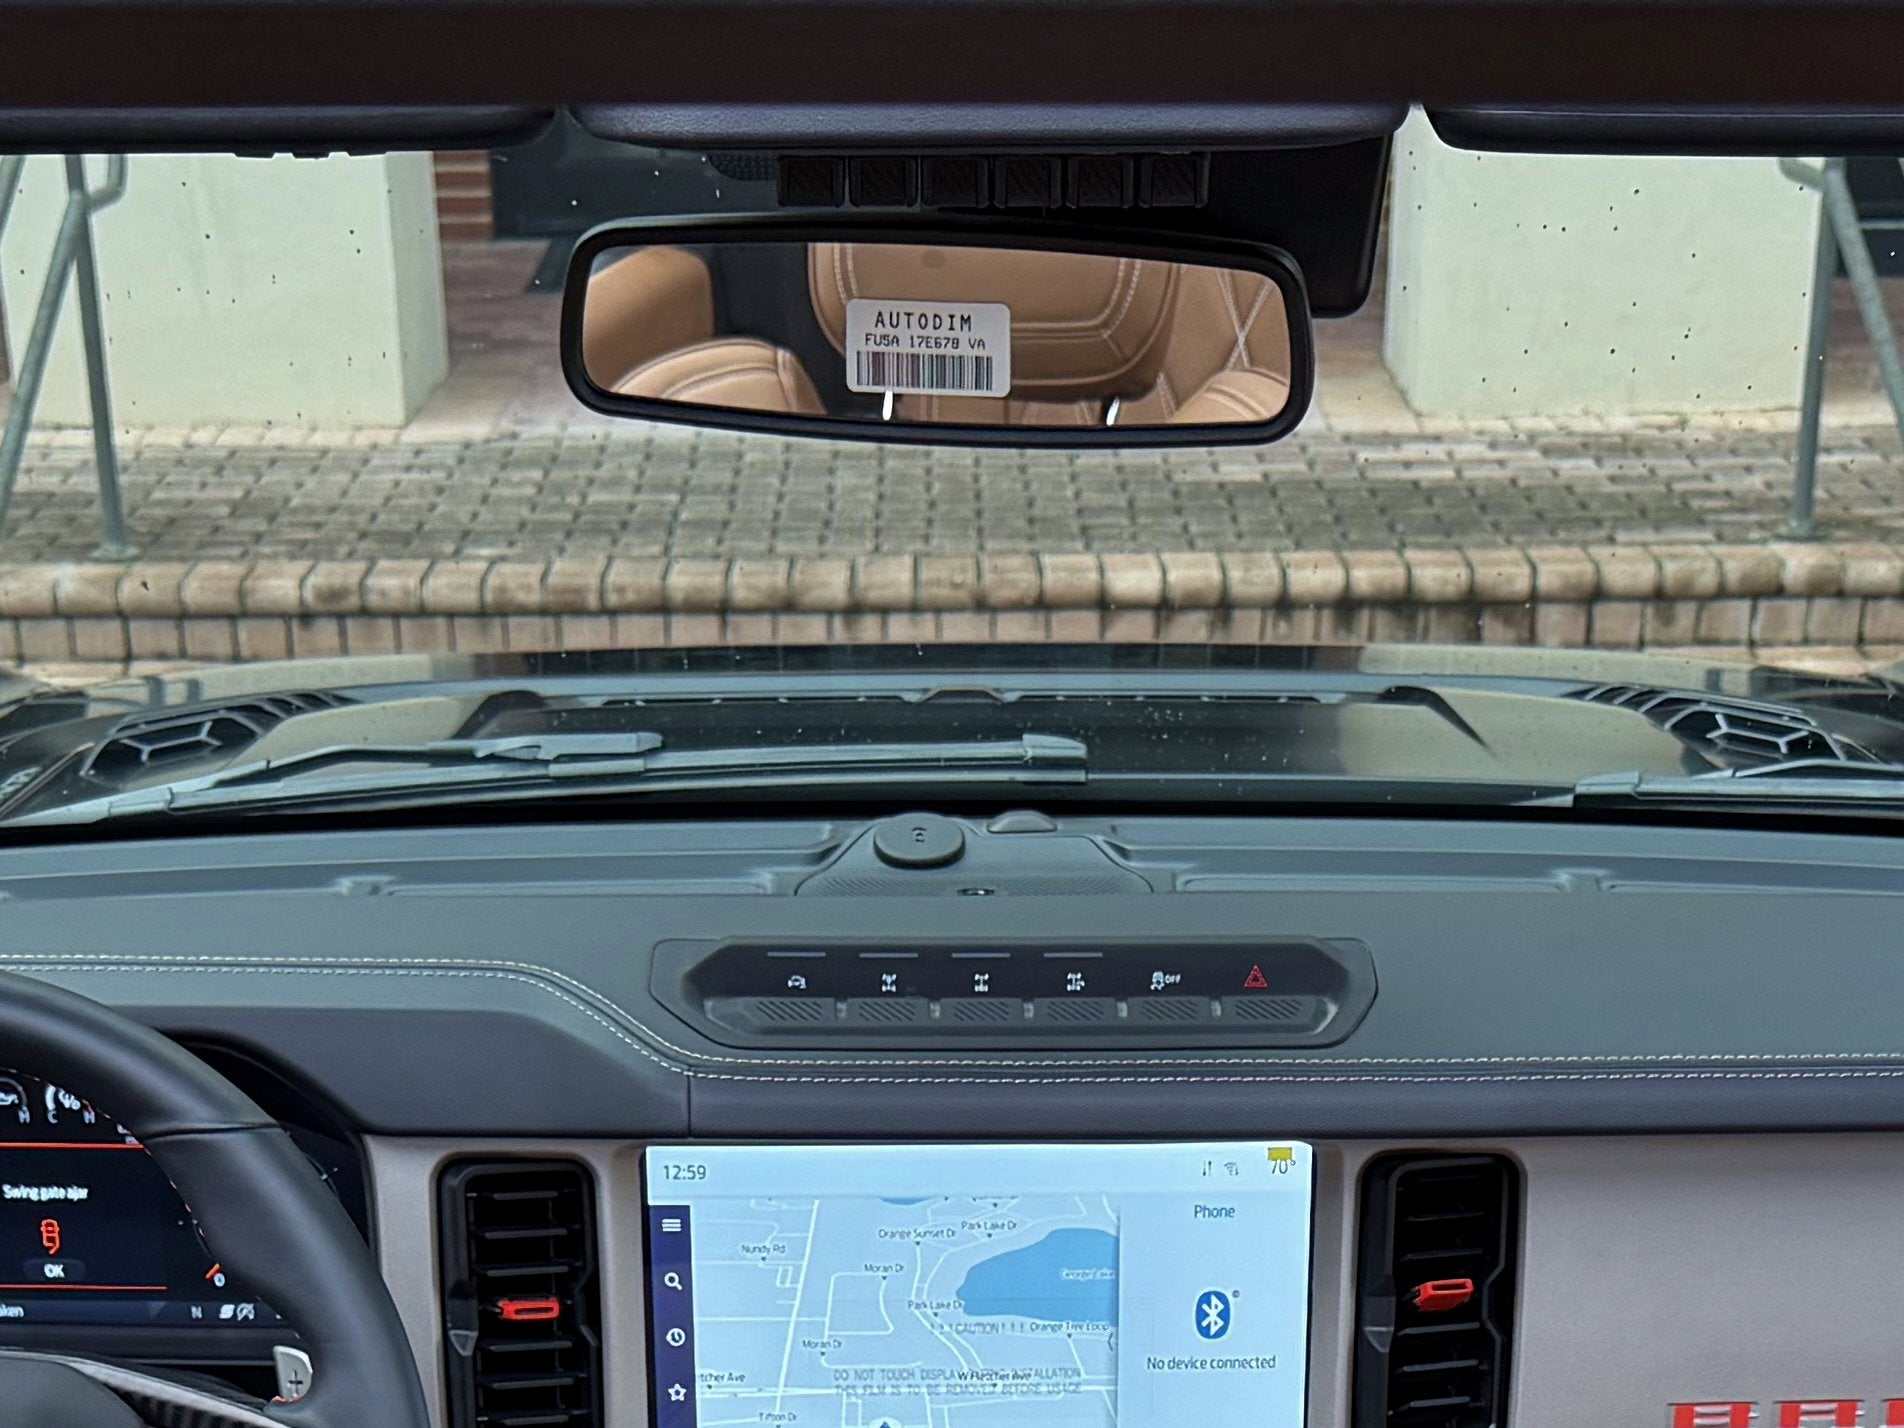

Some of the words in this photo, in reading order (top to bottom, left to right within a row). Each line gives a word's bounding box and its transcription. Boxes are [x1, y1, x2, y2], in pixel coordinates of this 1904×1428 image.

[874, 310, 973, 332] AUTODIM
[865, 333, 900, 347] FU5A
[968, 338, 986, 350] VA
[663, 1164, 707, 1180] 12:59
[1194, 1204, 1236, 1218] Phone
[43, 1264, 65, 1278] OK
[1147, 1356, 1166, 1370] No
[1167, 1356, 1208, 1370] device
[1210, 1355, 1277, 1370] connected
[921, 1369, 959, 1381] DISPLA
